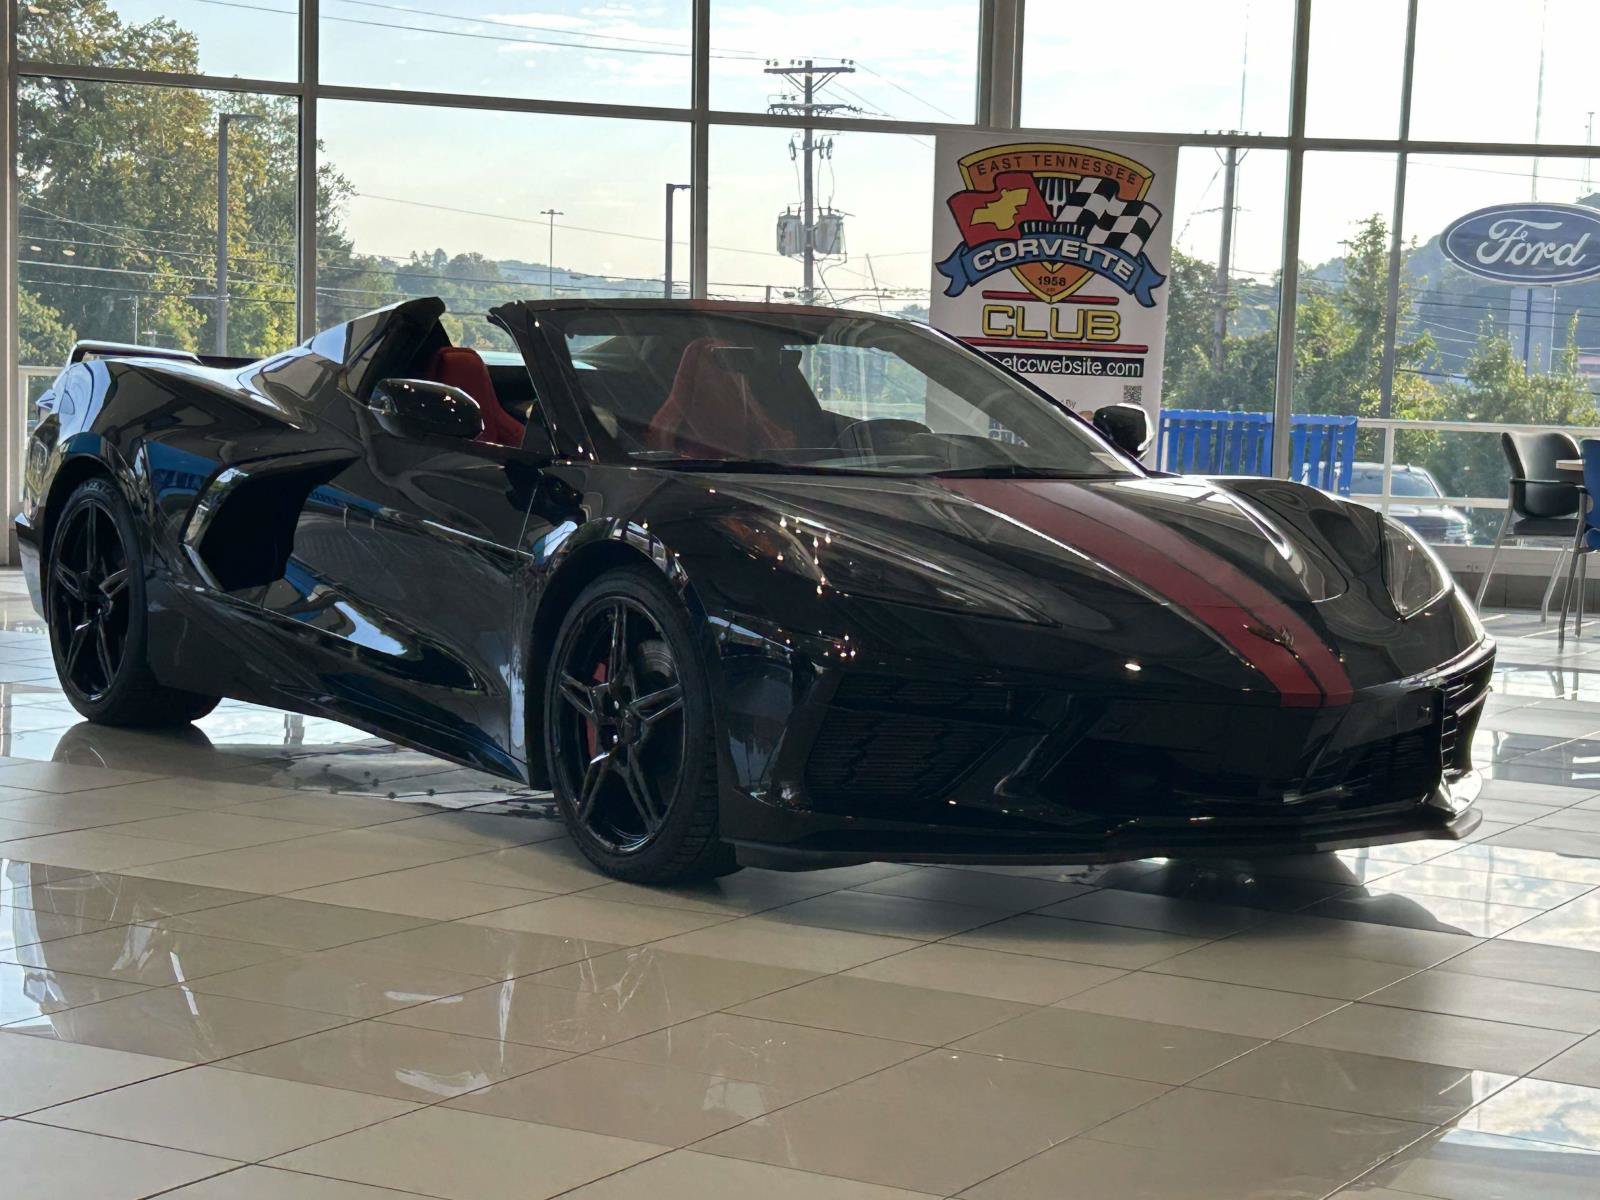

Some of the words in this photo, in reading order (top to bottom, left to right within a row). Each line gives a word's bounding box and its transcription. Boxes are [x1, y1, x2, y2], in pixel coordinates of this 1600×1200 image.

[977, 156, 1022, 176] EAST
[1032, 154, 1138, 185] TENNESSEE
[972, 238, 1135, 282] CORVETTE
[1476, 218, 1591, 267] Ford
[1038, 275, 1066, 286] 1958
[982, 304, 1121, 342] CLUB
